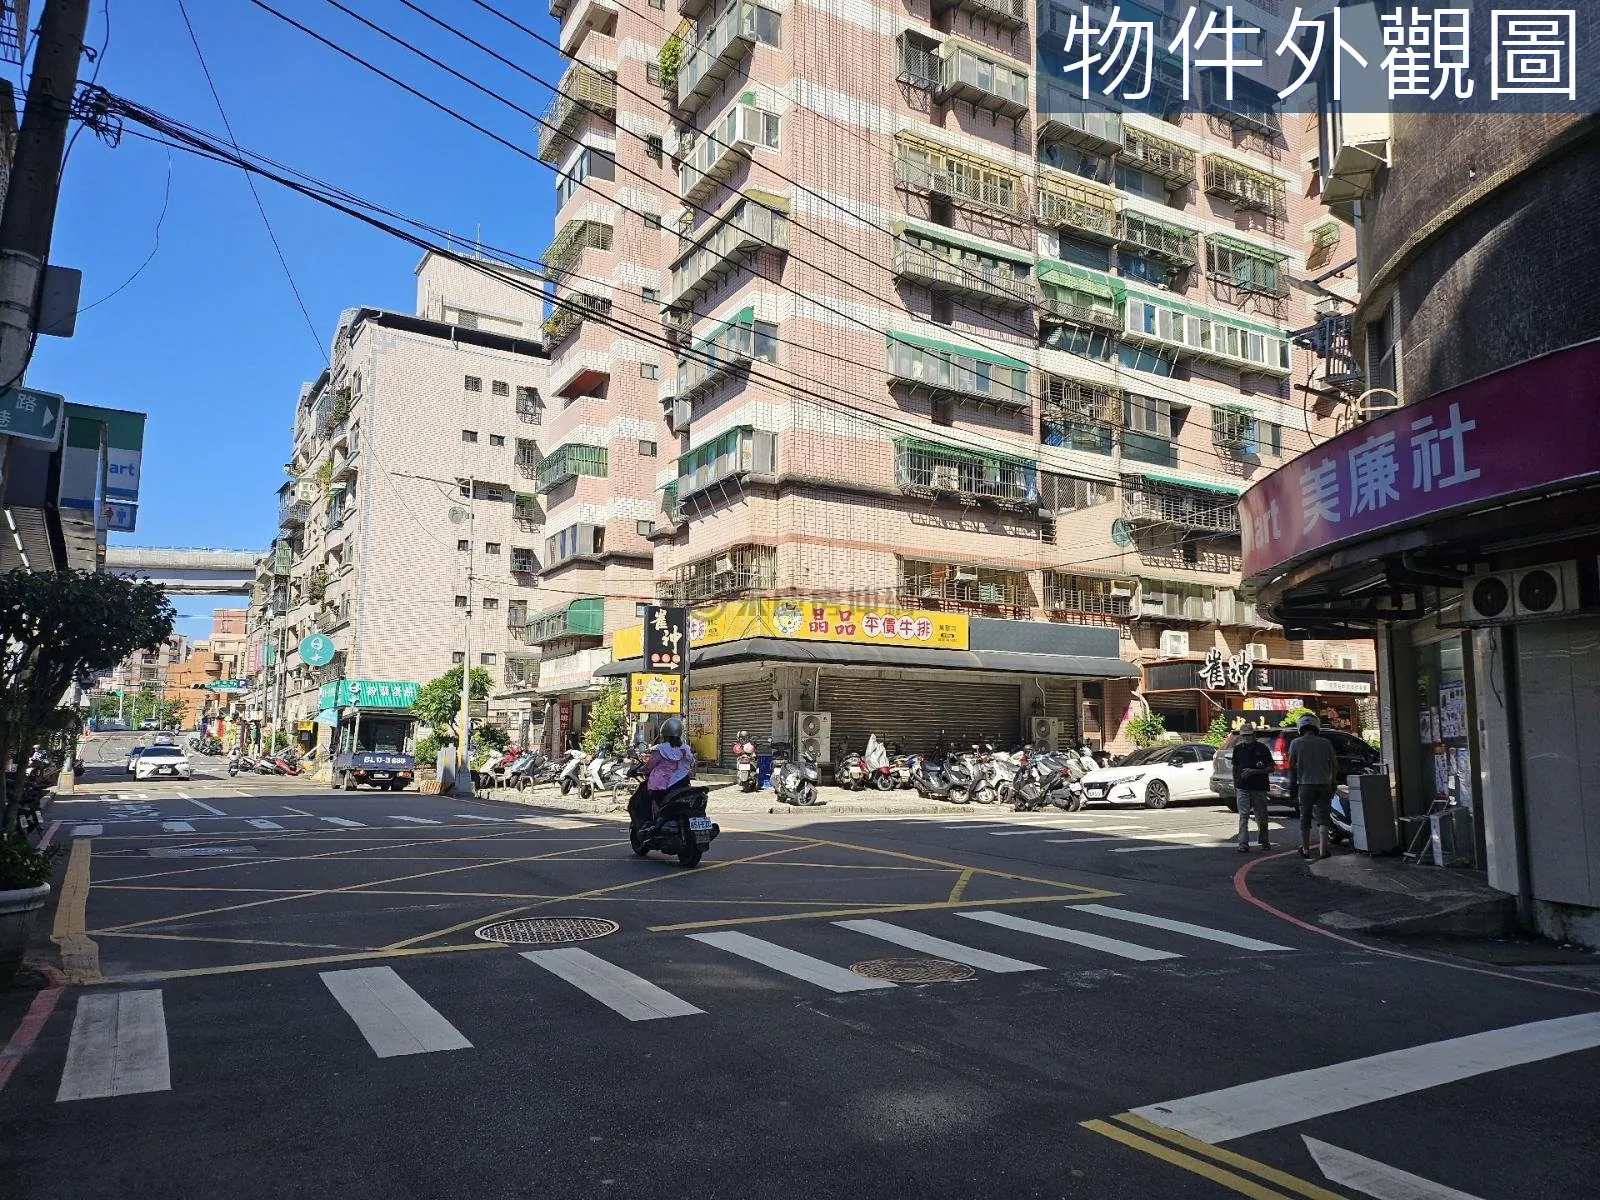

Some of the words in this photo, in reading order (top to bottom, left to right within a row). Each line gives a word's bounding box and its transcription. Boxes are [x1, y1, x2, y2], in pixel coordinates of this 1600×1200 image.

[15, 393, 38, 413] 路
[1299, 402, 1481, 536] 美廉社
